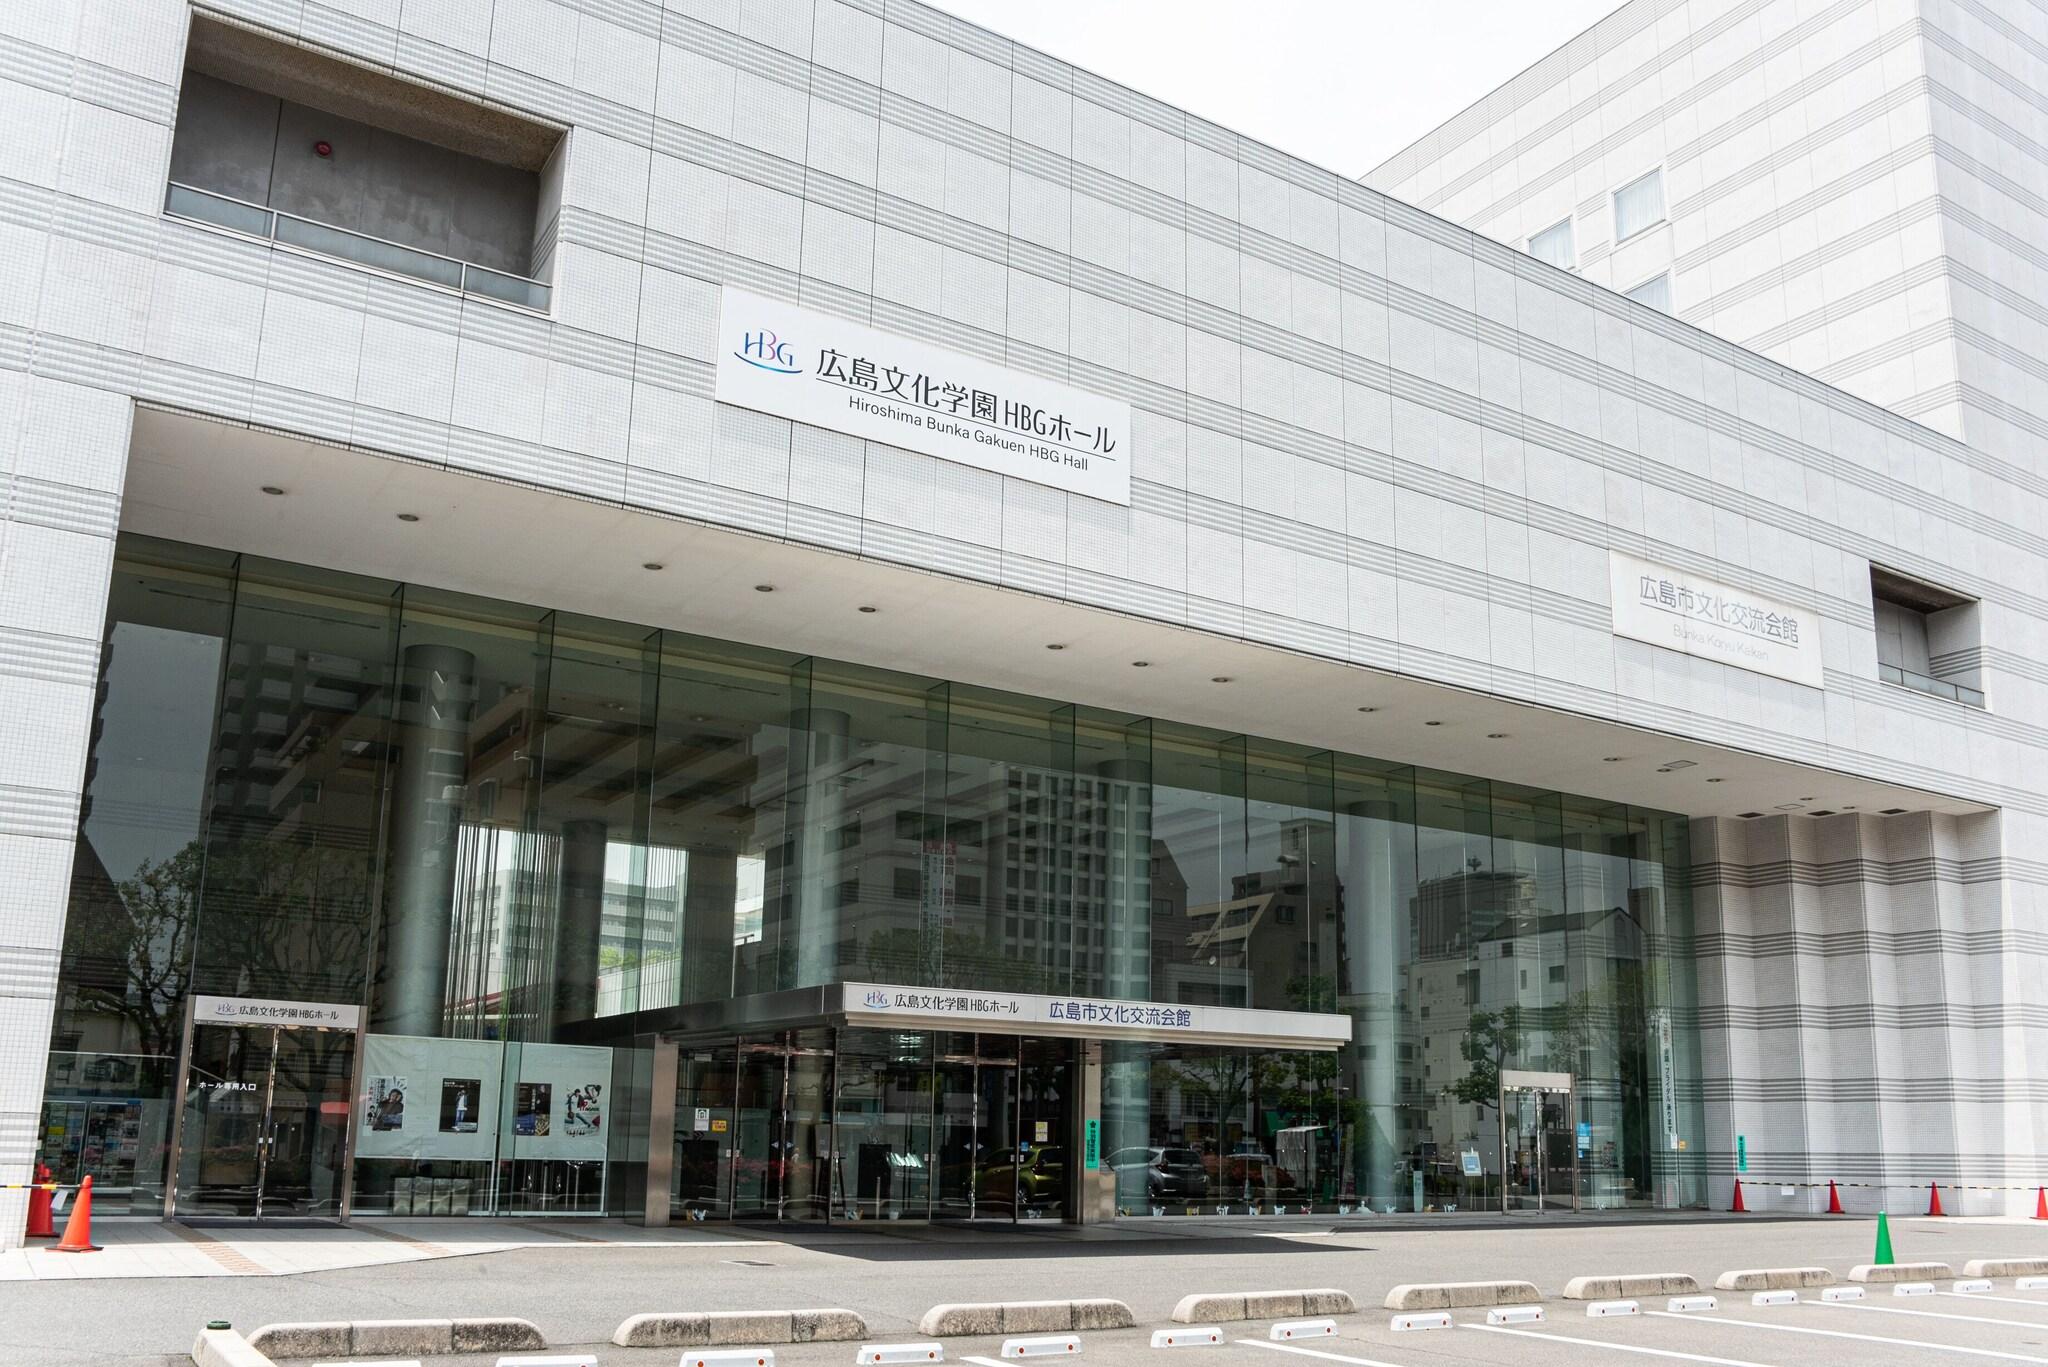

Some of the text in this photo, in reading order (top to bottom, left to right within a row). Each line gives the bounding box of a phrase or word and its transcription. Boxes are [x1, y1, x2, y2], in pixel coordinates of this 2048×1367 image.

[744, 328, 793, 366] HBG
[849, 395, 1088, 471] Hiroshima Bunka Gakuen HBG Hall
[1639, 575, 1799, 643] 広島市文化交流会館
[1049, 1001, 1192, 1027] 広島市文化交流会館
